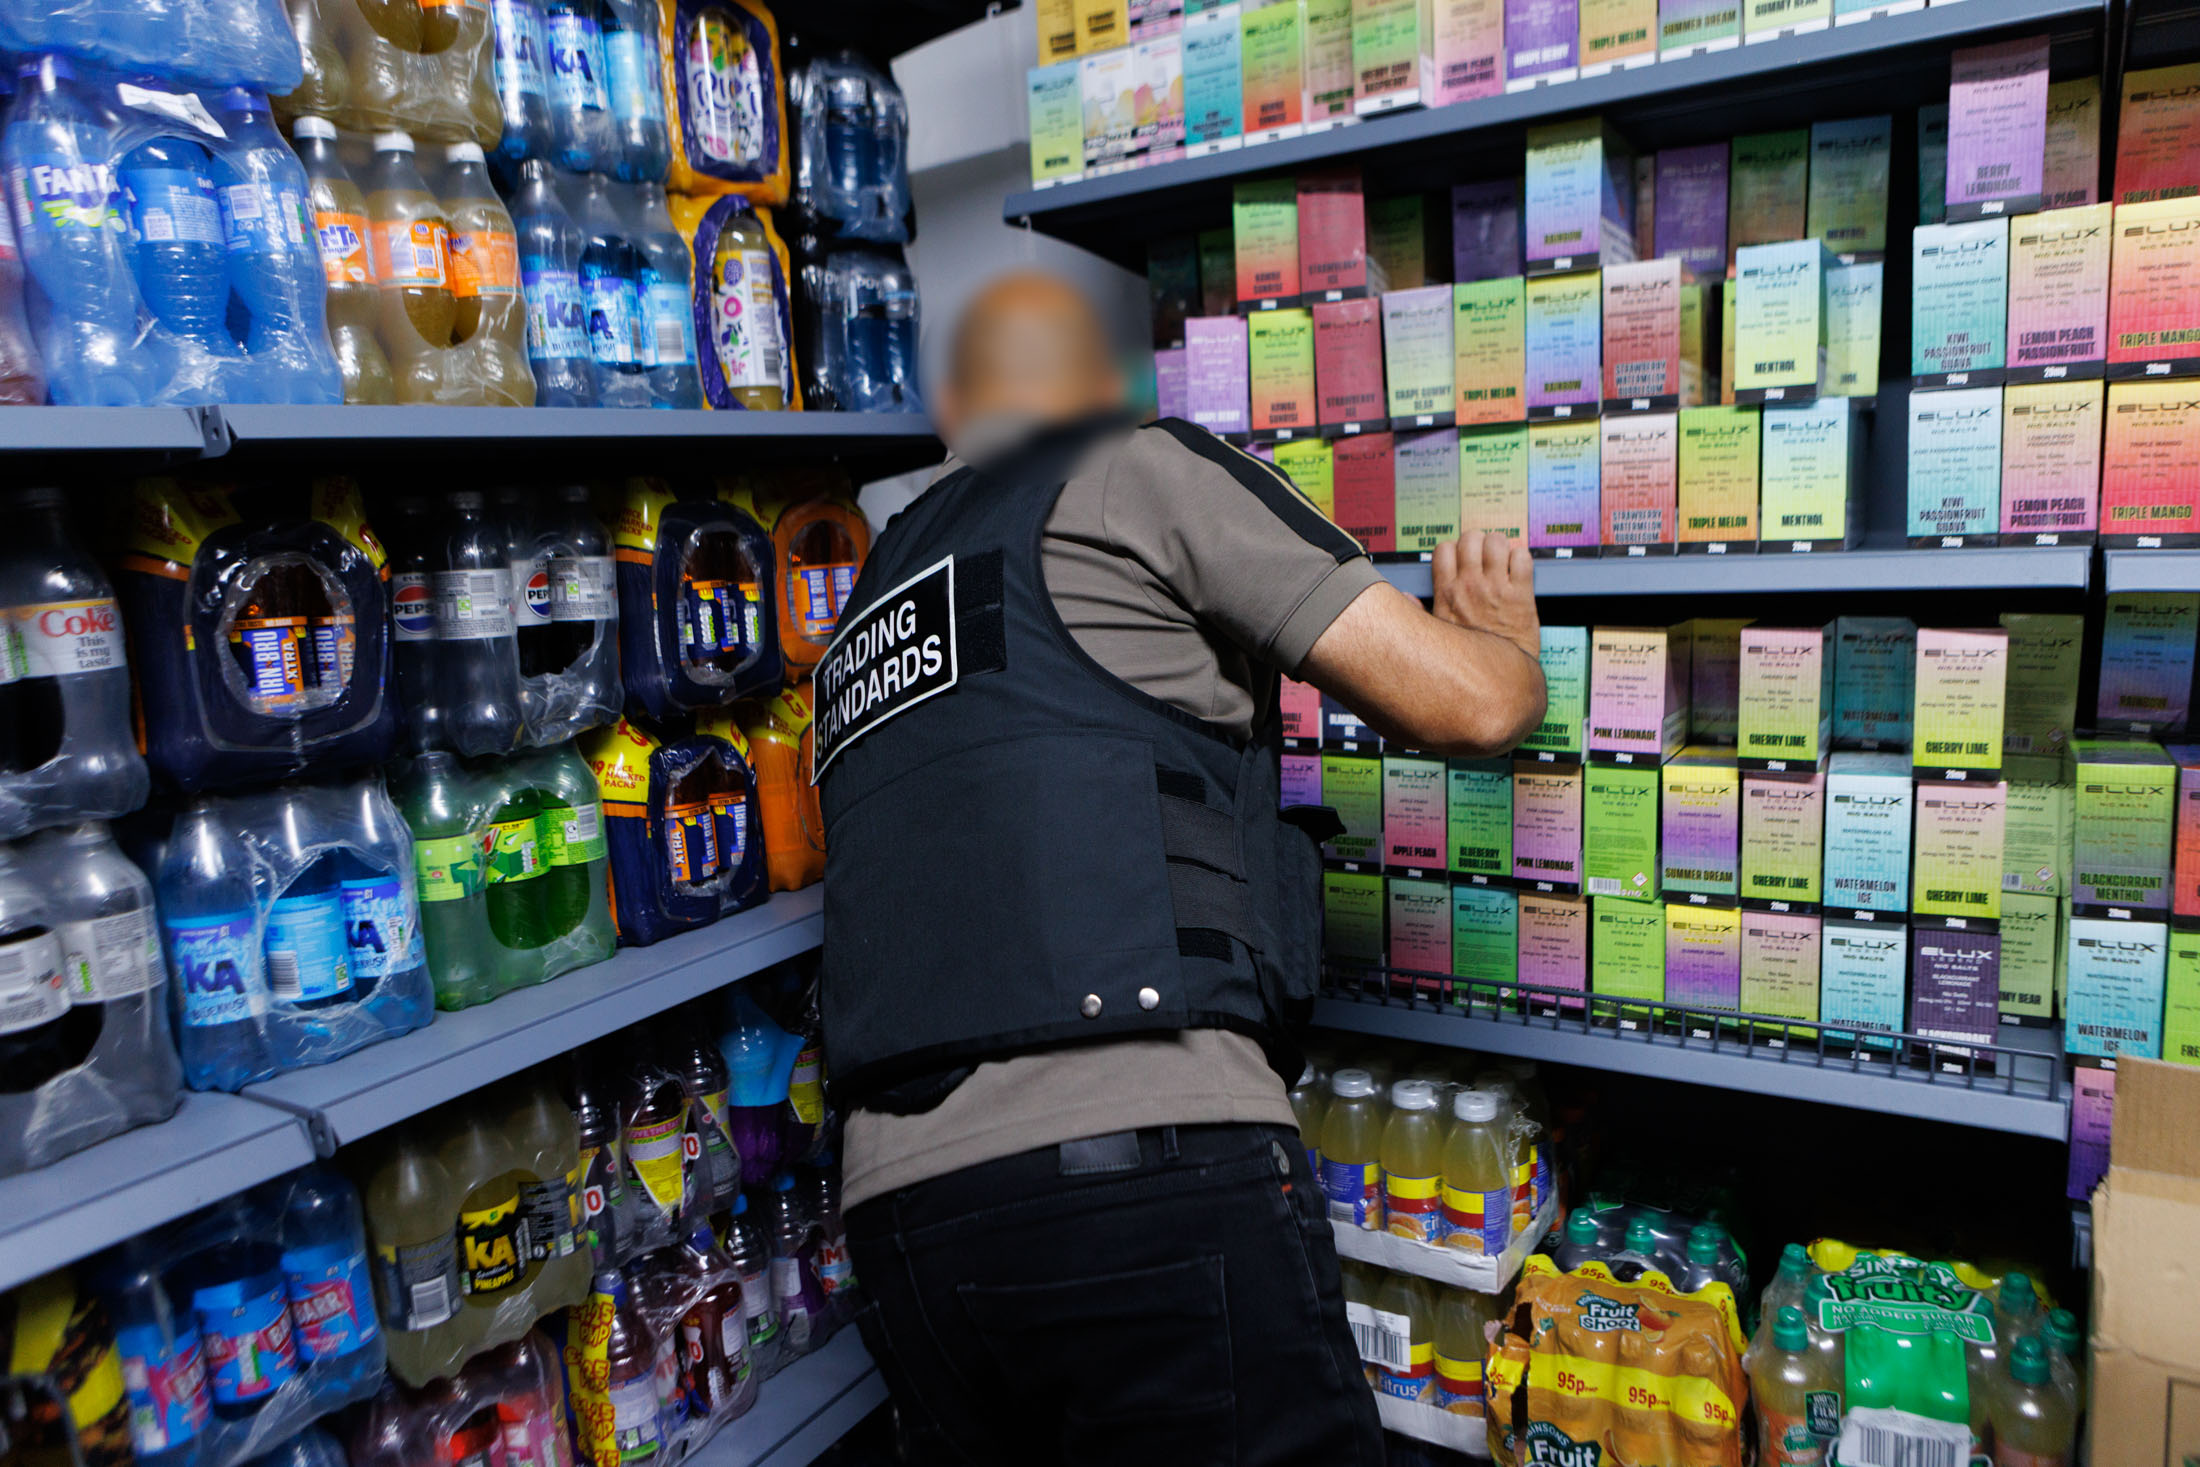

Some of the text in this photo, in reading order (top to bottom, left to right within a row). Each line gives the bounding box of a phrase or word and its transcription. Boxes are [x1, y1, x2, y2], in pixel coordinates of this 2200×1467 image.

[32, 164, 120, 195] FANTA
[2019, 227, 2100, 246] ELUX
[1921, 239, 1997, 257] ELUX
[1947, 333, 1969, 345] KIWI
[2020, 327, 2094, 345] LEMON PEACH
[2119, 328, 2200, 348] TRIPLE MANGO
[1924, 343, 1991, 359] PASSIONFRUIT
[2018, 342, 2095, 361] PASSIONFRUIT
[1941, 358, 1971, 370] GUAVA
[1917, 407, 1993, 421] ELUX
[2013, 401, 2092, 416] ELUX
[2117, 400, 2200, 414] ELUX
[1942, 497, 1964, 510] KIWI
[2012, 497, 2085, 513] LEMON PEACH
[1920, 507, 1985, 521] PASSIONFRUIT
[2112, 504, 2192, 520] TRIPLE MANGO
[1688, 516, 1748, 529] TRIPLE MELON
[2010, 512, 2086, 527] PASSIONFRUIT
[1936, 522, 1966, 533] GUAVA
[40, 608, 116, 637] Coke
[77, 636, 105, 646] This
[824, 600, 916, 700] TRADING
[1747, 645, 1812, 655] ELUX
[1924, 648, 1998, 658] ELUX
[79, 658, 112, 668] taste
[283, 642, 298, 680] XTRA
[816, 635, 942, 760] STANDARDS
[1594, 727, 1656, 741] PINK LEMONADE
[1749, 734, 1806, 747] CHERRY LIME
[1925, 741, 1989, 755] CHERRY LIME
[607, 764, 633, 772] PRICE
[606, 771, 645, 782] MARKED
[604, 780, 636, 789] PACKS
[1669, 785, 1729, 794] ELUX
[2085, 785, 2164, 796] ELUX
[1751, 790, 1816, 800] ELUX
[1834, 795, 1903, 806] ELUX
[1925, 799, 1996, 811] ELUX
[672, 831, 685, 864] XTRA
[1393, 845, 1413, 857] APPLE
[1516, 857, 1574, 872] PINK LEMONADE
[1665, 868, 1733, 882] SUMMER DREAM
[1753, 874, 1809, 889] CHERRY LIME
[2080, 872, 2162, 889] BLACKCURRANT
[1834, 878, 1897, 894] WATERMELON
[1857, 892, 1872, 904] ICE
[1926, 889, 1988, 905] CHERRY LIME
[2095, 888, 2144, 902] MENTHOL
[1524, 906, 1579, 917] ELUX
[1600, 915, 1658, 925] ELUX
[1673, 922, 1733, 933] ELUX
[1749, 929, 1812, 940] ELUX
[1831, 938, 1899, 950] ELUX
[2078, 938, 2156, 952] ELUX
[1921, 946, 1992, 960] ELUX
[184, 954, 245, 994] KA
[2019, 993, 2041, 1005] BEAR
[2078, 1023, 2148, 1043] WATERMELON
[2104, 1039, 2120, 1052] ICE
[465, 1234, 516, 1270] KA
[474, 1270, 514, 1290] PINEAPPLE
[1581, 1268, 1605, 1279] 95p
[1831, 1274, 1976, 1310] fruity
[1590, 1304, 1635, 1318] Fruit
[1832, 1305, 1975, 1325] NO ADDED SUGAR
[1582, 1316, 1641, 1331] Shoot
[1557, 1372, 1585, 1395] 95p
[1629, 1387, 1657, 1408] 95p
[1704, 1402, 1728, 1424] 95p
[1534, 1440, 1595, 1467] Fruit
